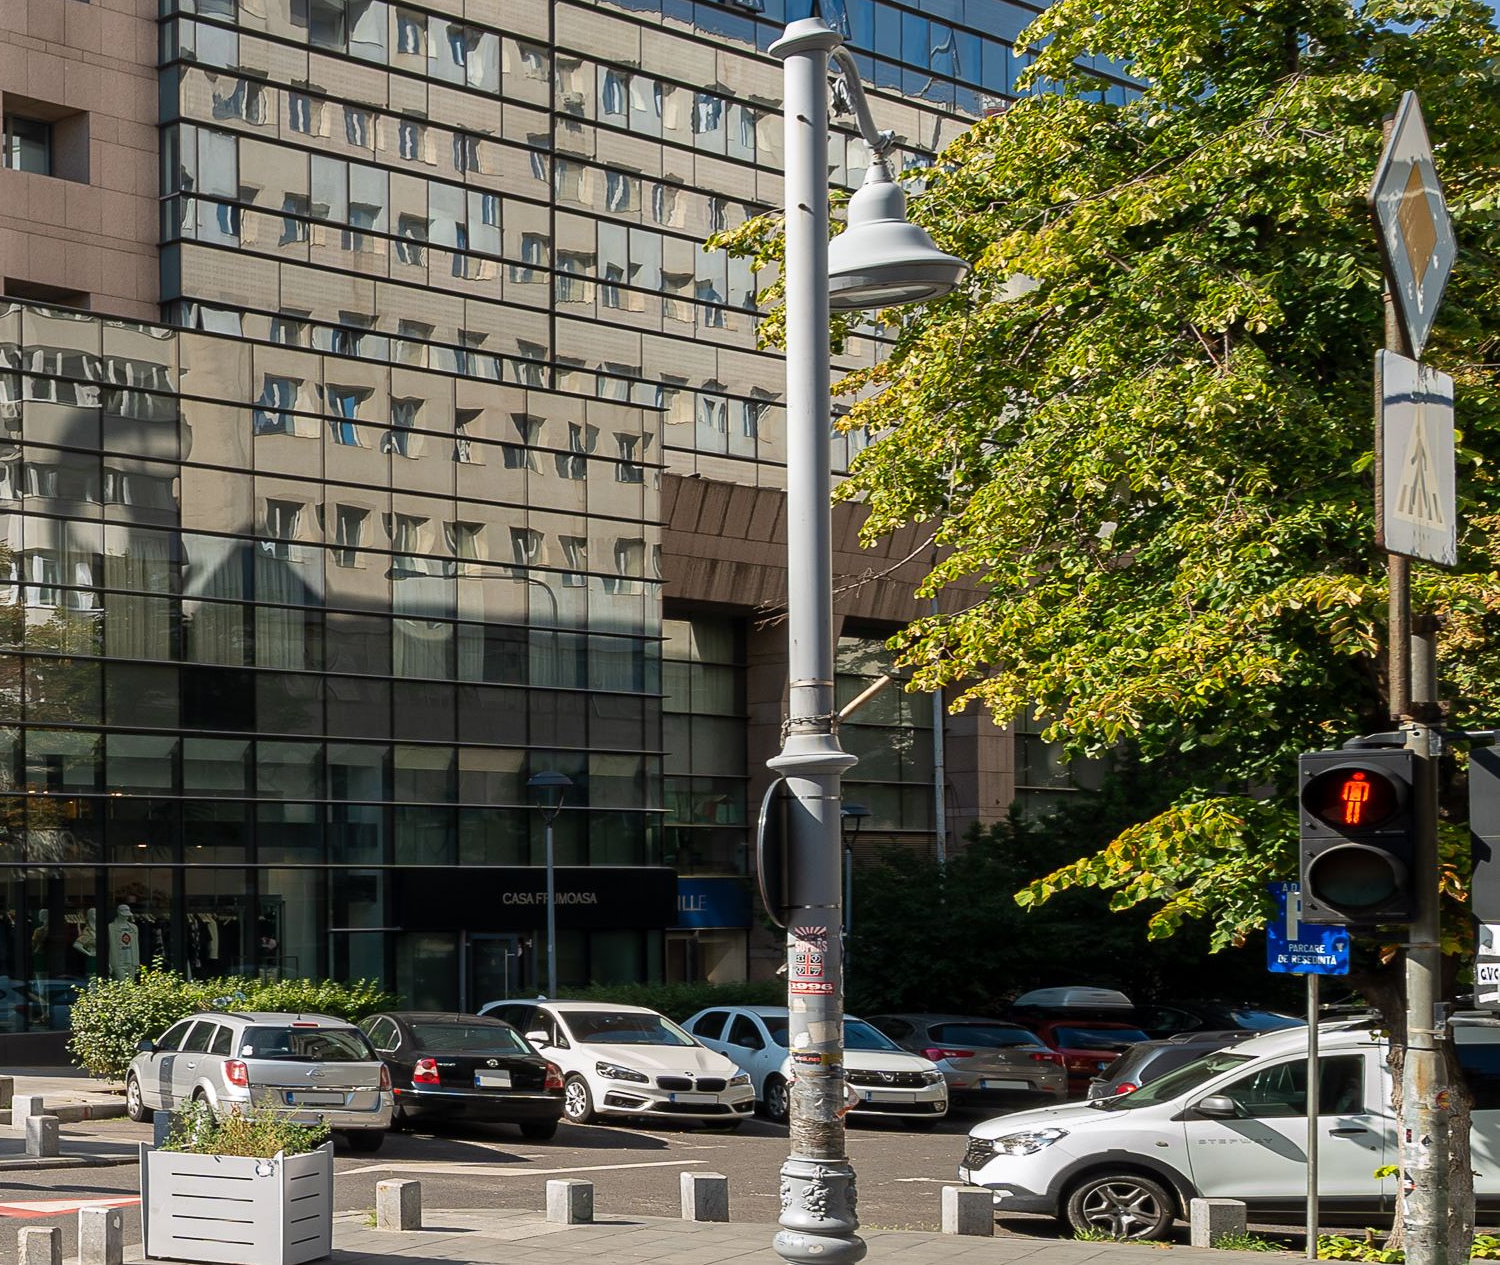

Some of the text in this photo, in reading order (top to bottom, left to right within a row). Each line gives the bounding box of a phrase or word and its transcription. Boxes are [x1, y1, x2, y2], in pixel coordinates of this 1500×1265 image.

[502, 892, 534, 904] CASA
[1288, 944, 1326, 953] PARCARE
[1278, 955, 1289, 963] DE
